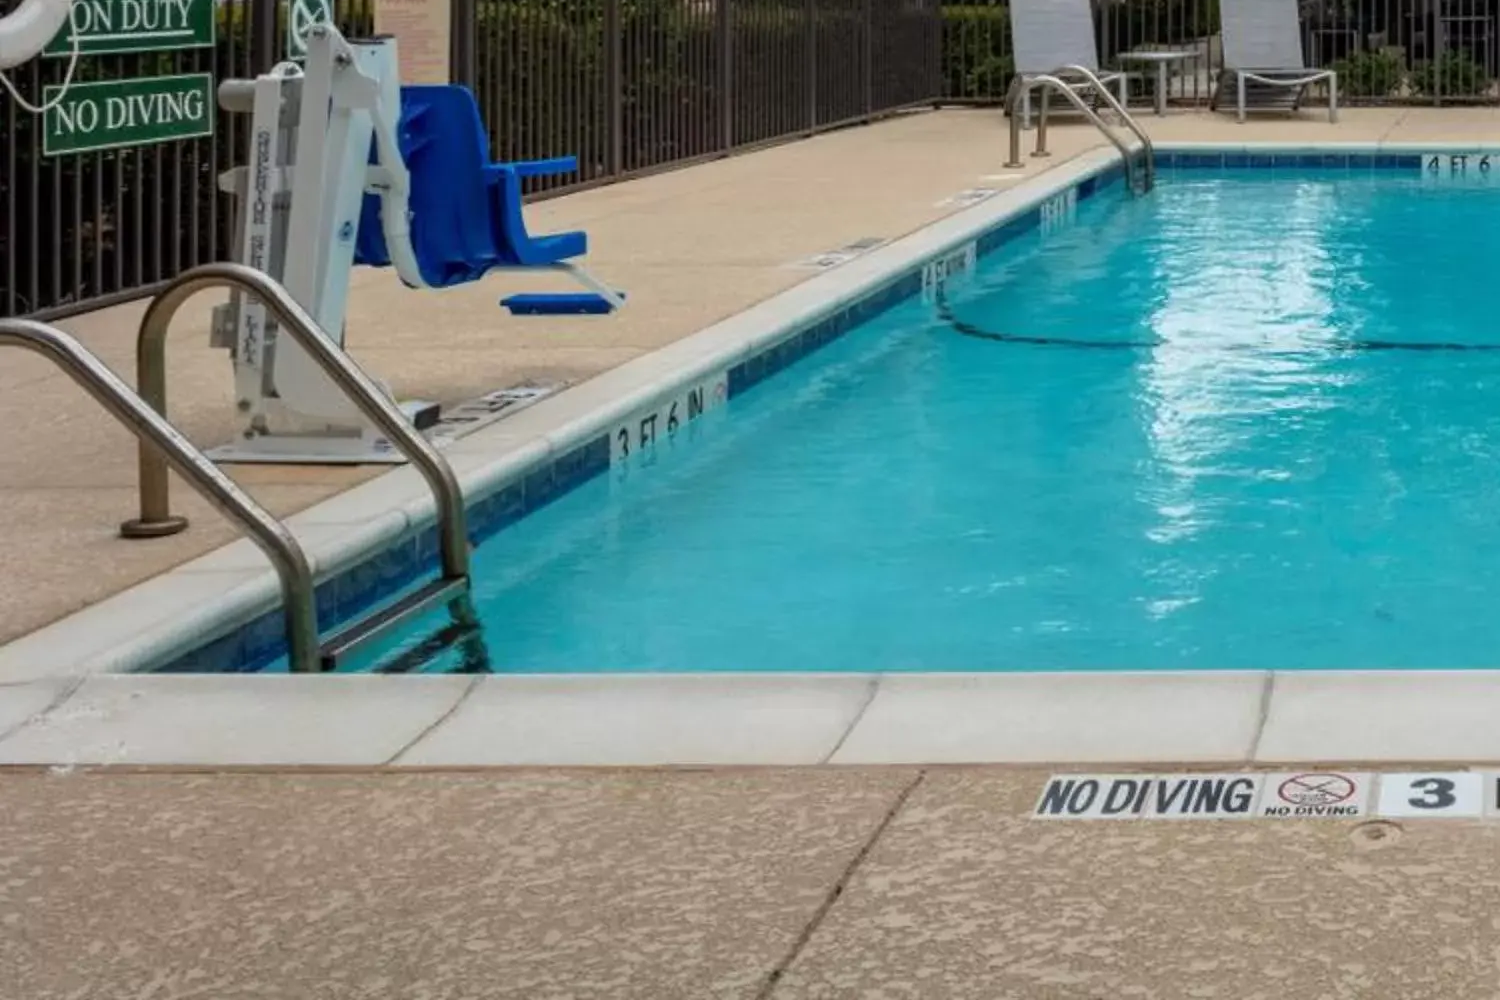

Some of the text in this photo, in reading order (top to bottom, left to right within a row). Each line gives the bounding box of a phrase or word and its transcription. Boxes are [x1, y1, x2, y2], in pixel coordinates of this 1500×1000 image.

[71, 0, 113, 34] ON
[54, 89, 204, 136] NO DIVING
[1479, 154, 1491, 172] 6
[640, 412, 658, 449] FT
[667, 400, 680, 436] 6
[1036, 778, 1254, 815] NO DIVING
[1407, 777, 1457, 809] 3
[1264, 805, 1359, 816] NO DIVING
